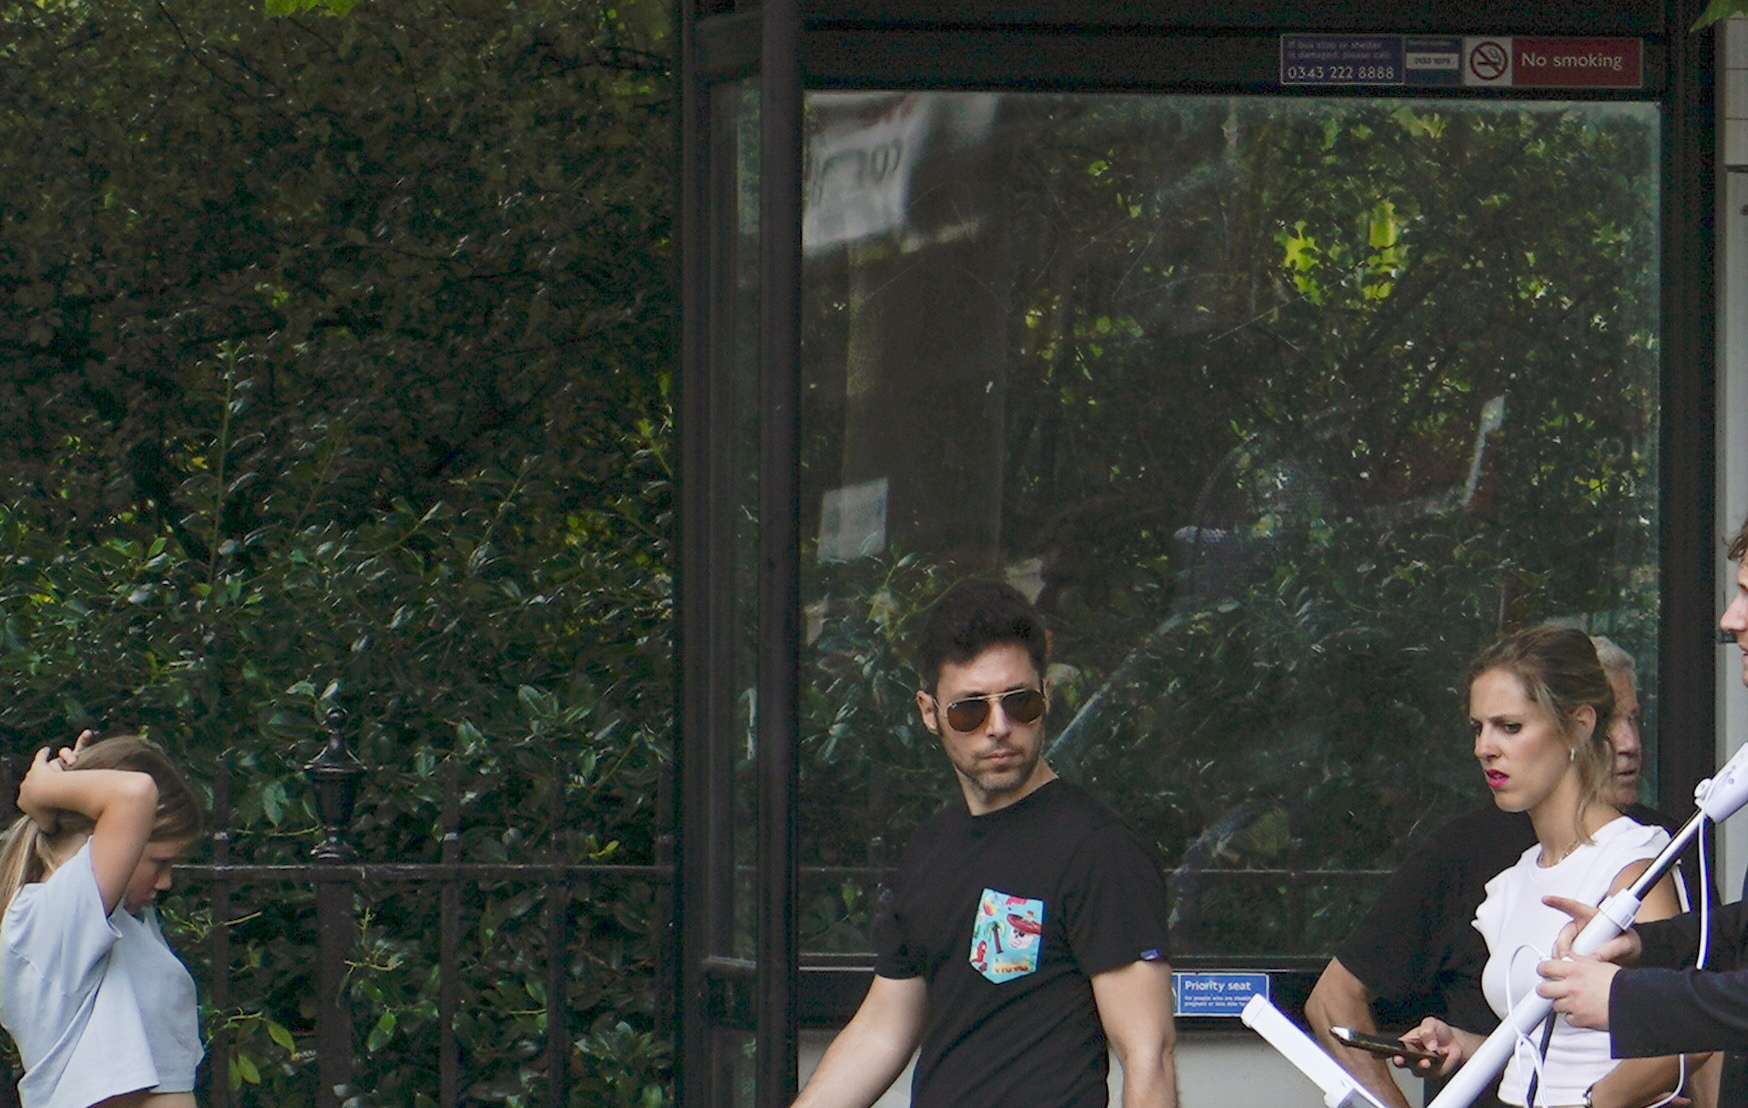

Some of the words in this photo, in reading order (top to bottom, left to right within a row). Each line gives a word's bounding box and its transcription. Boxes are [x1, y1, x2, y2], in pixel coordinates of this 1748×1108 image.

[1521, 53, 1547, 67] No
[1553, 52, 1623, 71] smoking
[1288, 66, 1324, 79] 0343
[1329, 66, 1353, 79] 222
[1358, 66, 1394, 79] 8888
[1184, 980, 1226, 993] Priority
[1227, 980, 1252, 991] seat
